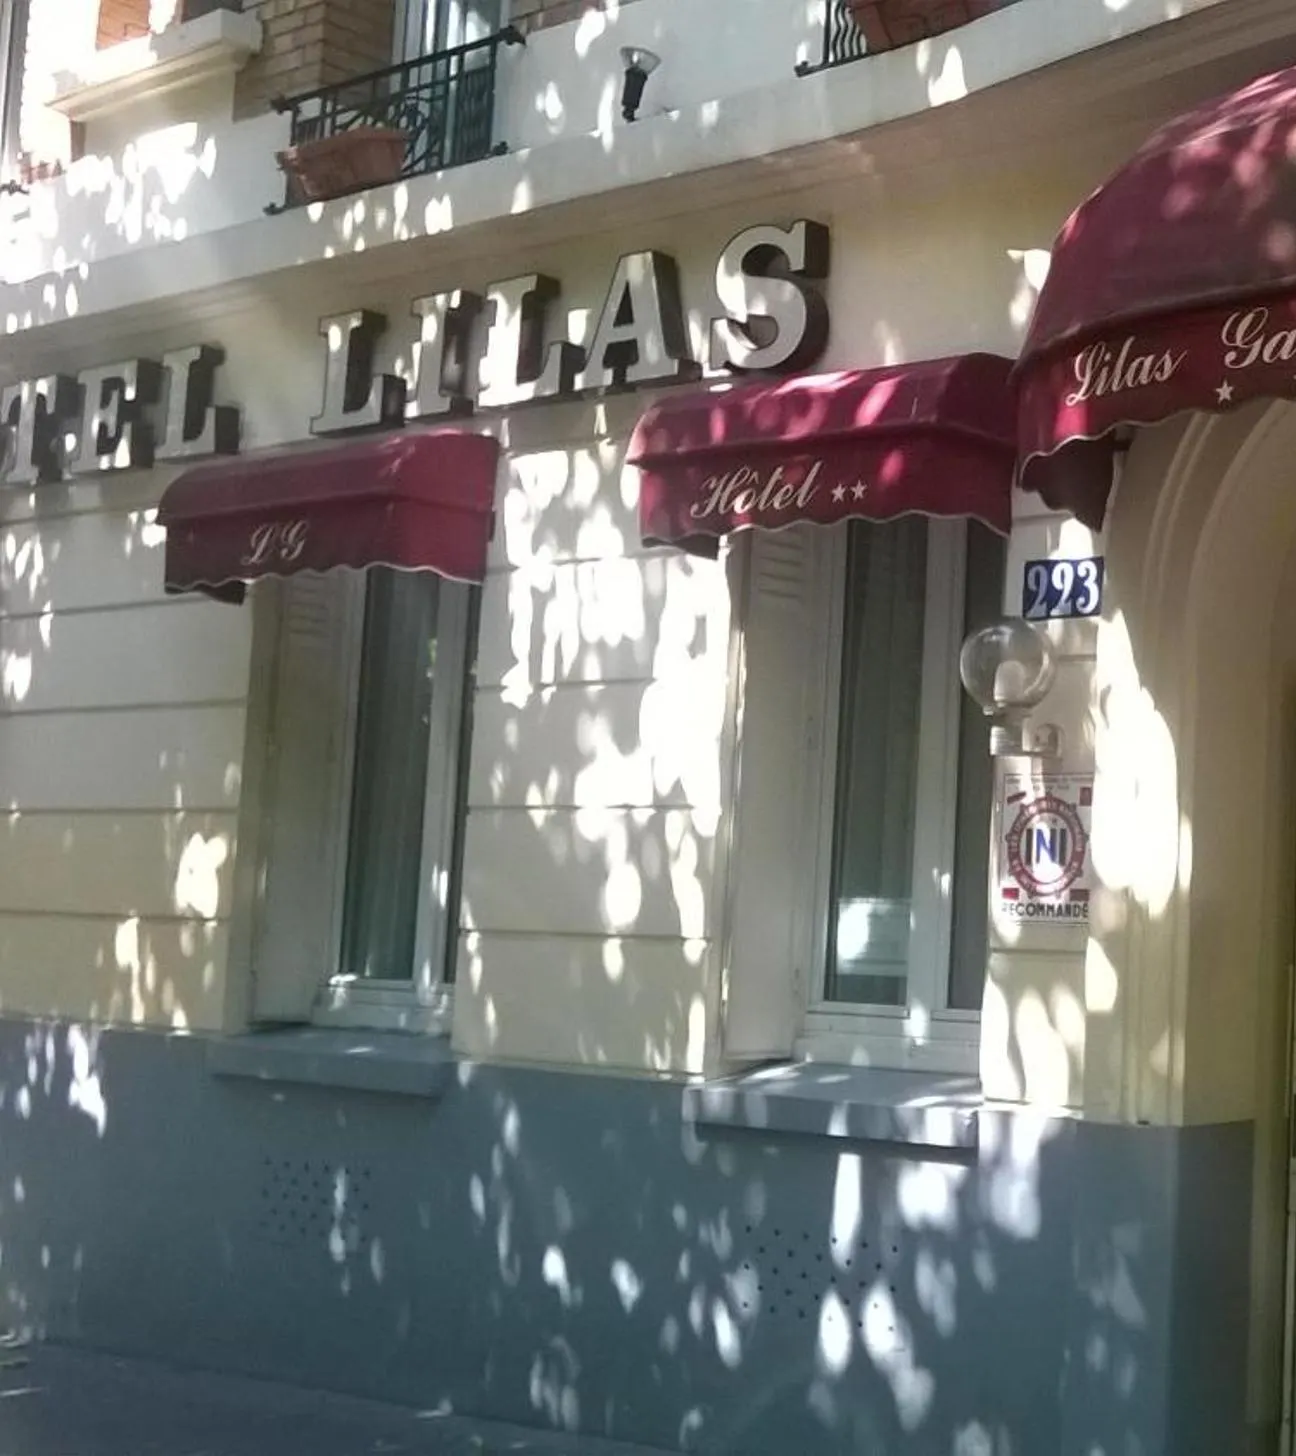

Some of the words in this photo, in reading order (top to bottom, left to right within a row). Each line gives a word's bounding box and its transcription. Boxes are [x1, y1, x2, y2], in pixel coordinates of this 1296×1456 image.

[309, 219, 829, 435] LILAS
[1065, 336, 1188, 407] Lilas
[690, 460, 824, 518] Hôtel
[1026, 561, 1100, 618] 223
